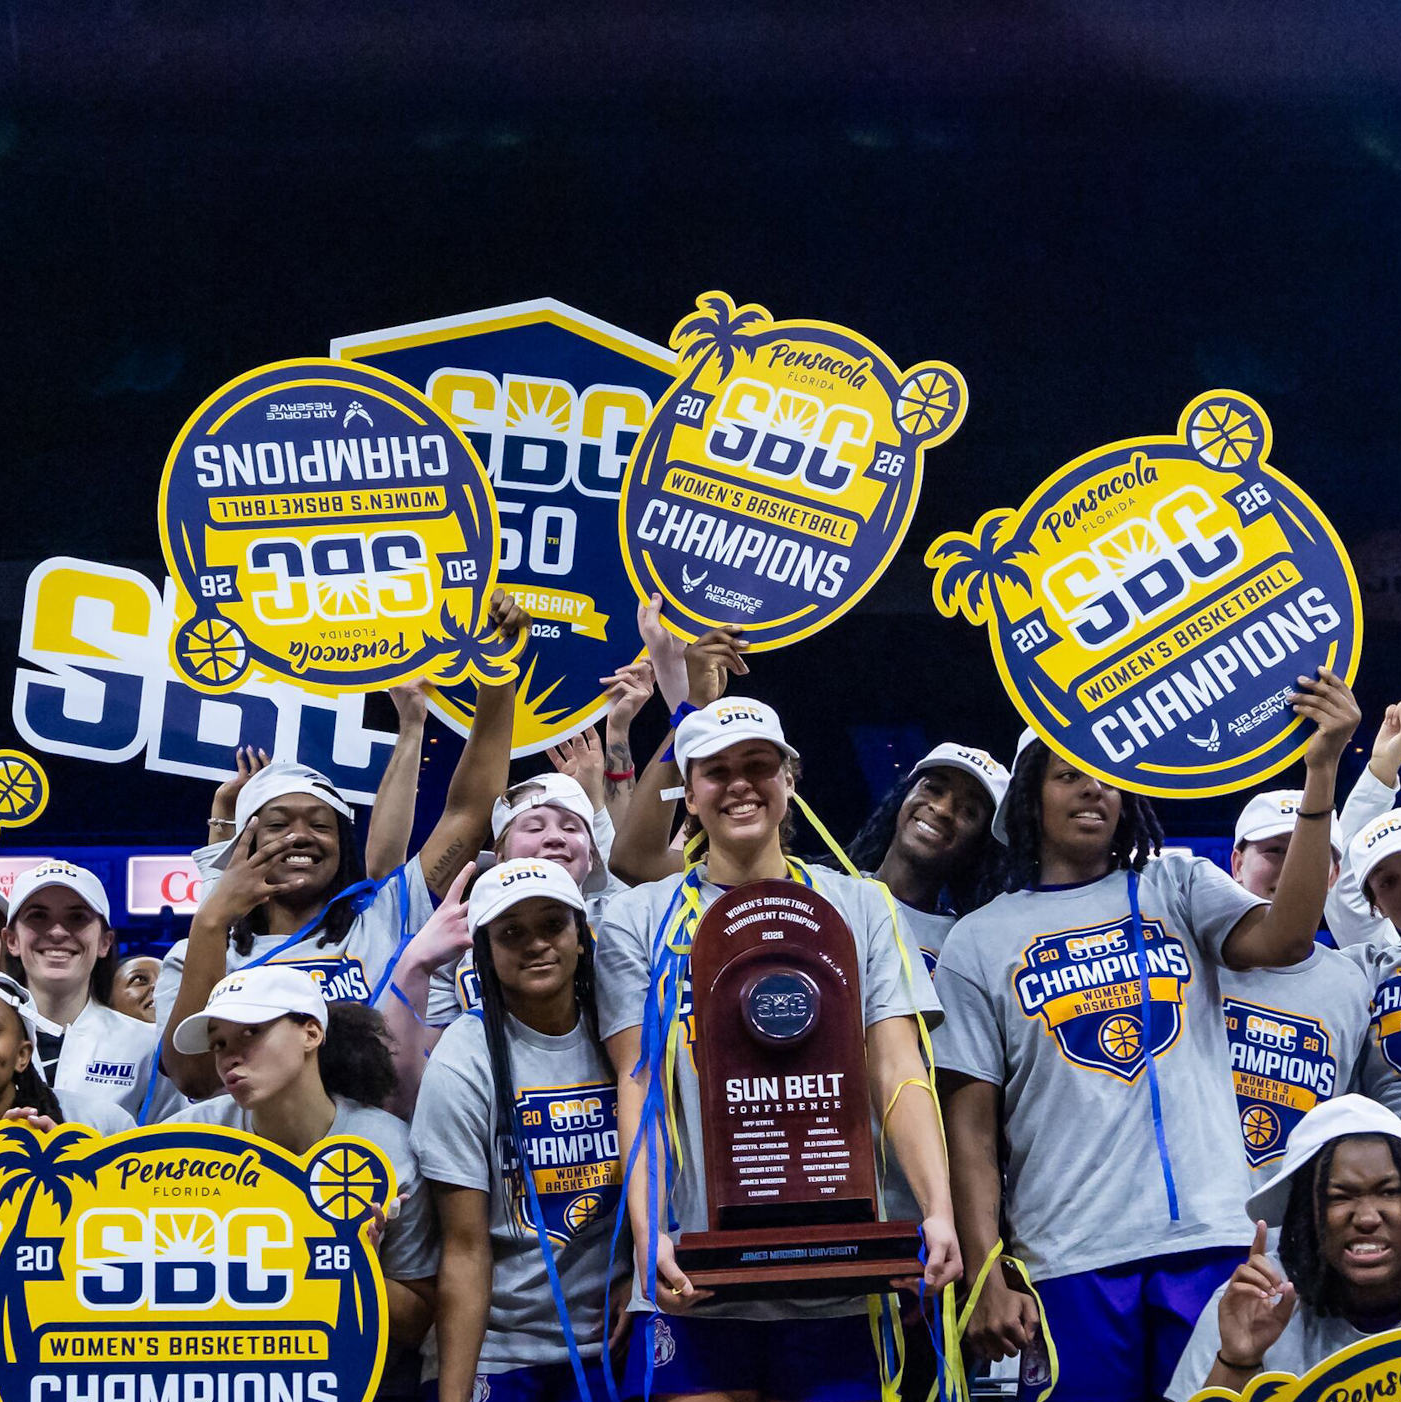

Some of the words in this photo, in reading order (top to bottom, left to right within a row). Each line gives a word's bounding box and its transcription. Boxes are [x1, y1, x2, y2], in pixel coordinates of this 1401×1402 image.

[769, 344, 869, 390] Pensacola
[788, 371, 833, 390] FLORIDA
[675, 395, 705, 420] 20
[707, 379, 870, 492] SBC
[874, 451, 905, 476] 26
[193, 435, 448, 487] CHAMPIONS
[217, 496, 343, 517] BASKETBALL
[350, 491, 439, 509] WOMEN'S
[671, 473, 743, 507] WOMEN'S
[745, 496, 847, 539] BASKETBALL
[1042, 457, 1158, 541] Pensacola
[496, 501, 577, 575] 50
[637, 499, 850, 598] CHAMPIONS
[246, 529, 433, 625] SBC
[446, 559, 477, 581] 20
[1011, 619, 1048, 653] 20
[1044, 487, 1241, 648] SBC
[1236, 483, 1272, 515] 26
[200, 574, 231, 596] 26
[705, 584, 725, 596] AIR
[726, 591, 764, 608] FORCE
[705, 592, 756, 614] RESERVE
[1084, 641, 1173, 702] WOMEN'S
[1174, 569, 1293, 648] BASKETBALL
[288, 634, 409, 668] Pensacola
[1092, 587, 1340, 763] CHAMPIONS
[717, 706, 763, 725] SBC
[500, 865, 547, 887] SBC
[726, 898, 762, 919] WOMEN'S
[764, 897, 814, 916] BASKETBALL
[724, 911, 778, 936] TOURNAMENT
[779, 911, 821, 932] CHAMPION
[762, 931, 784, 940] 2026
[1039, 949, 1059, 963] 20
[1065, 929, 1128, 961] SBC
[1082, 981, 1141, 1002] WOMEN'S
[1245, 1015, 1297, 1052] SBC
[1303, 1036, 1319, 1051] 26
[86, 1061, 135, 1079] JMU
[726, 1077, 779, 1102] SUN
[784, 1073, 844, 1099] BELT
[1240, 1075, 1290, 1094] WOMEN'S
[522, 1110, 542, 1126] 20
[549, 1097, 604, 1132] SBC
[728, 1101, 841, 1114] CONFERENCE
[116, 1156, 260, 1187] Pensacola
[556, 1163, 612, 1180] WOMEN'S
[154, 1187, 220, 1196] FLORIDA
[17, 1246, 53, 1270] 20
[76, 1208, 294, 1311] SBC
[316, 1246, 350, 1269] 26
[50, 1338, 158, 1356] WOMEN'S
[170, 1336, 318, 1355] BASKETBALL
